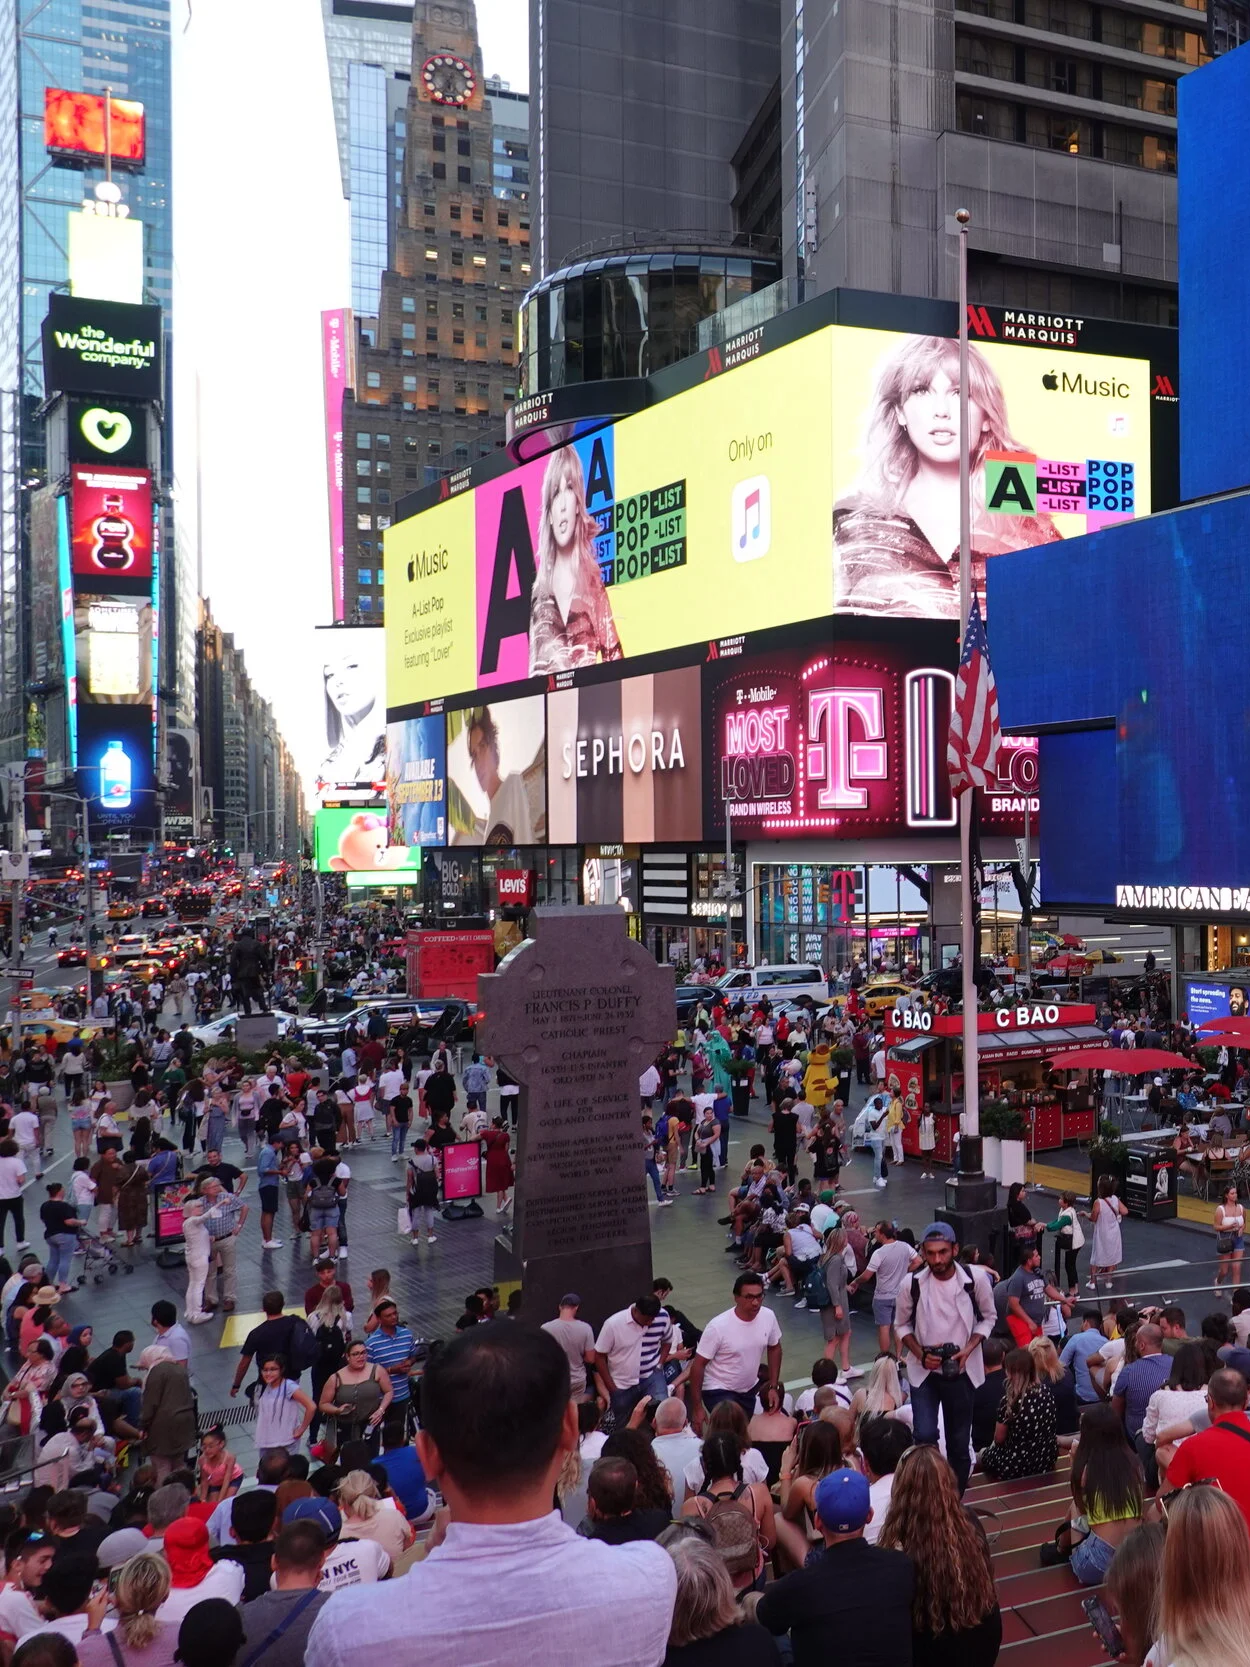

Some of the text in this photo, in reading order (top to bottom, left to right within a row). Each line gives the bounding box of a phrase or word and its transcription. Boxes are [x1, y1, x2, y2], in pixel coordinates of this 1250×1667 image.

[82, 199, 130, 219] 2019
[81, 325, 105, 339] the
[1004, 311, 1084, 331] MARRIOTT
[54, 331, 155, 357] Wonderful
[726, 326, 764, 353] MARRIOTT
[1004, 326, 1075, 345] MARQUIS
[726, 343, 760, 368] MARQUIS
[1061, 371, 1130, 399] Music
[514, 392, 554, 415] MARRIOTT
[514, 408, 548, 429] MARQUIS
[729, 432, 773, 463] Only on
[451, 467, 472, 483] MARRIOTT
[586, 436, 614, 509] A
[1042, 460, 1133, 477] -LIST POP
[451, 478, 471, 493] MARQUIS
[988, 466, 1035, 511] A
[1042, 477, 1133, 495] -LIST POP
[616, 485, 682, 529] POP -LIST
[1042, 494, 1133, 512] -LIST POP
[616, 515, 682, 556] POP -LIST
[415, 544, 449, 581] Music
[616, 551, 649, 583] POP
[654, 543, 683, 567] -LIST
[480, 486, 537, 676] A
[412, 596, 444, 618] A-List Pop
[404, 618, 453, 645] Exclusive playlist
[404, 650, 430, 670] featuring
[725, 705, 791, 754] MOST
[562, 728, 685, 781] SEPHORA
[404, 757, 435, 782] AVAILABLE
[721, 752, 796, 800] LOVED
[434, 779, 444, 802] 13
[749, 800, 791, 816] IN WIRELESS
[441, 861, 459, 882] BIG
[441, 882, 459, 896] BOLD
[1117, 885, 1223, 910] AMERICAN
[532, 984, 633, 1000] LIEUTENANT COLONEL
[525, 995, 642, 1014] FRANCIS P DUFFY
[532, 1016, 549, 1025] MAY
[892, 1008, 932, 1031] C BAO
[996, 1005, 1060, 1027] C BAO
[540, 1025, 627, 1041] CATHOLIC PRIEST
[561, 1049, 607, 1060] CHAPLAIN
[539, 1110, 632, 1127] GOD AND COUNTRY
[332, 1558, 358, 1576] NYC
